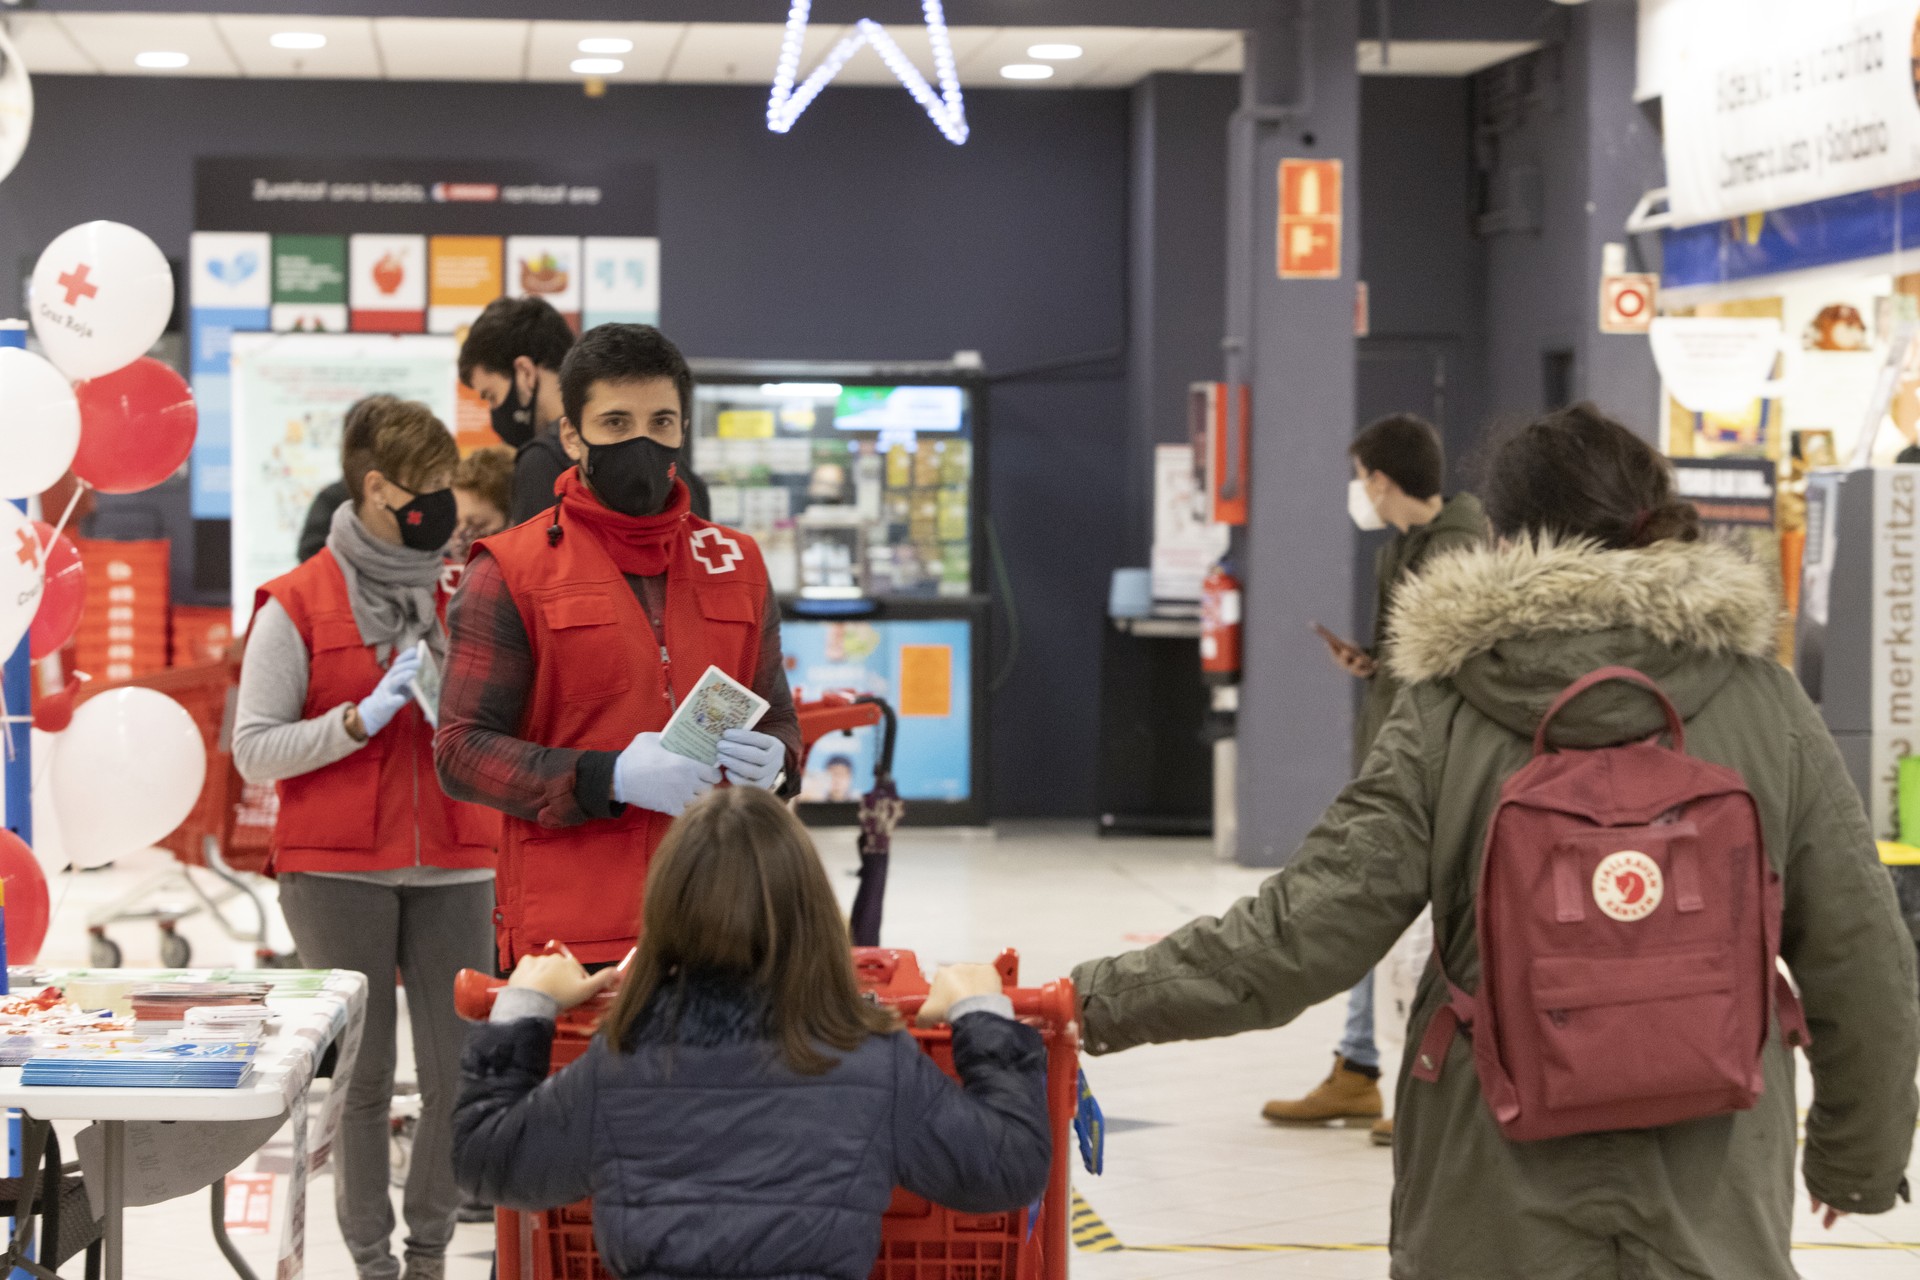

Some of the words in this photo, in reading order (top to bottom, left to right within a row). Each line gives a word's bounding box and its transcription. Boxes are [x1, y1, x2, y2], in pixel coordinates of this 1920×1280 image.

[40, 303, 63, 325] Cruz
[65, 314, 94, 339] Roja
[1884, 474, 1915, 726] merkataritza
